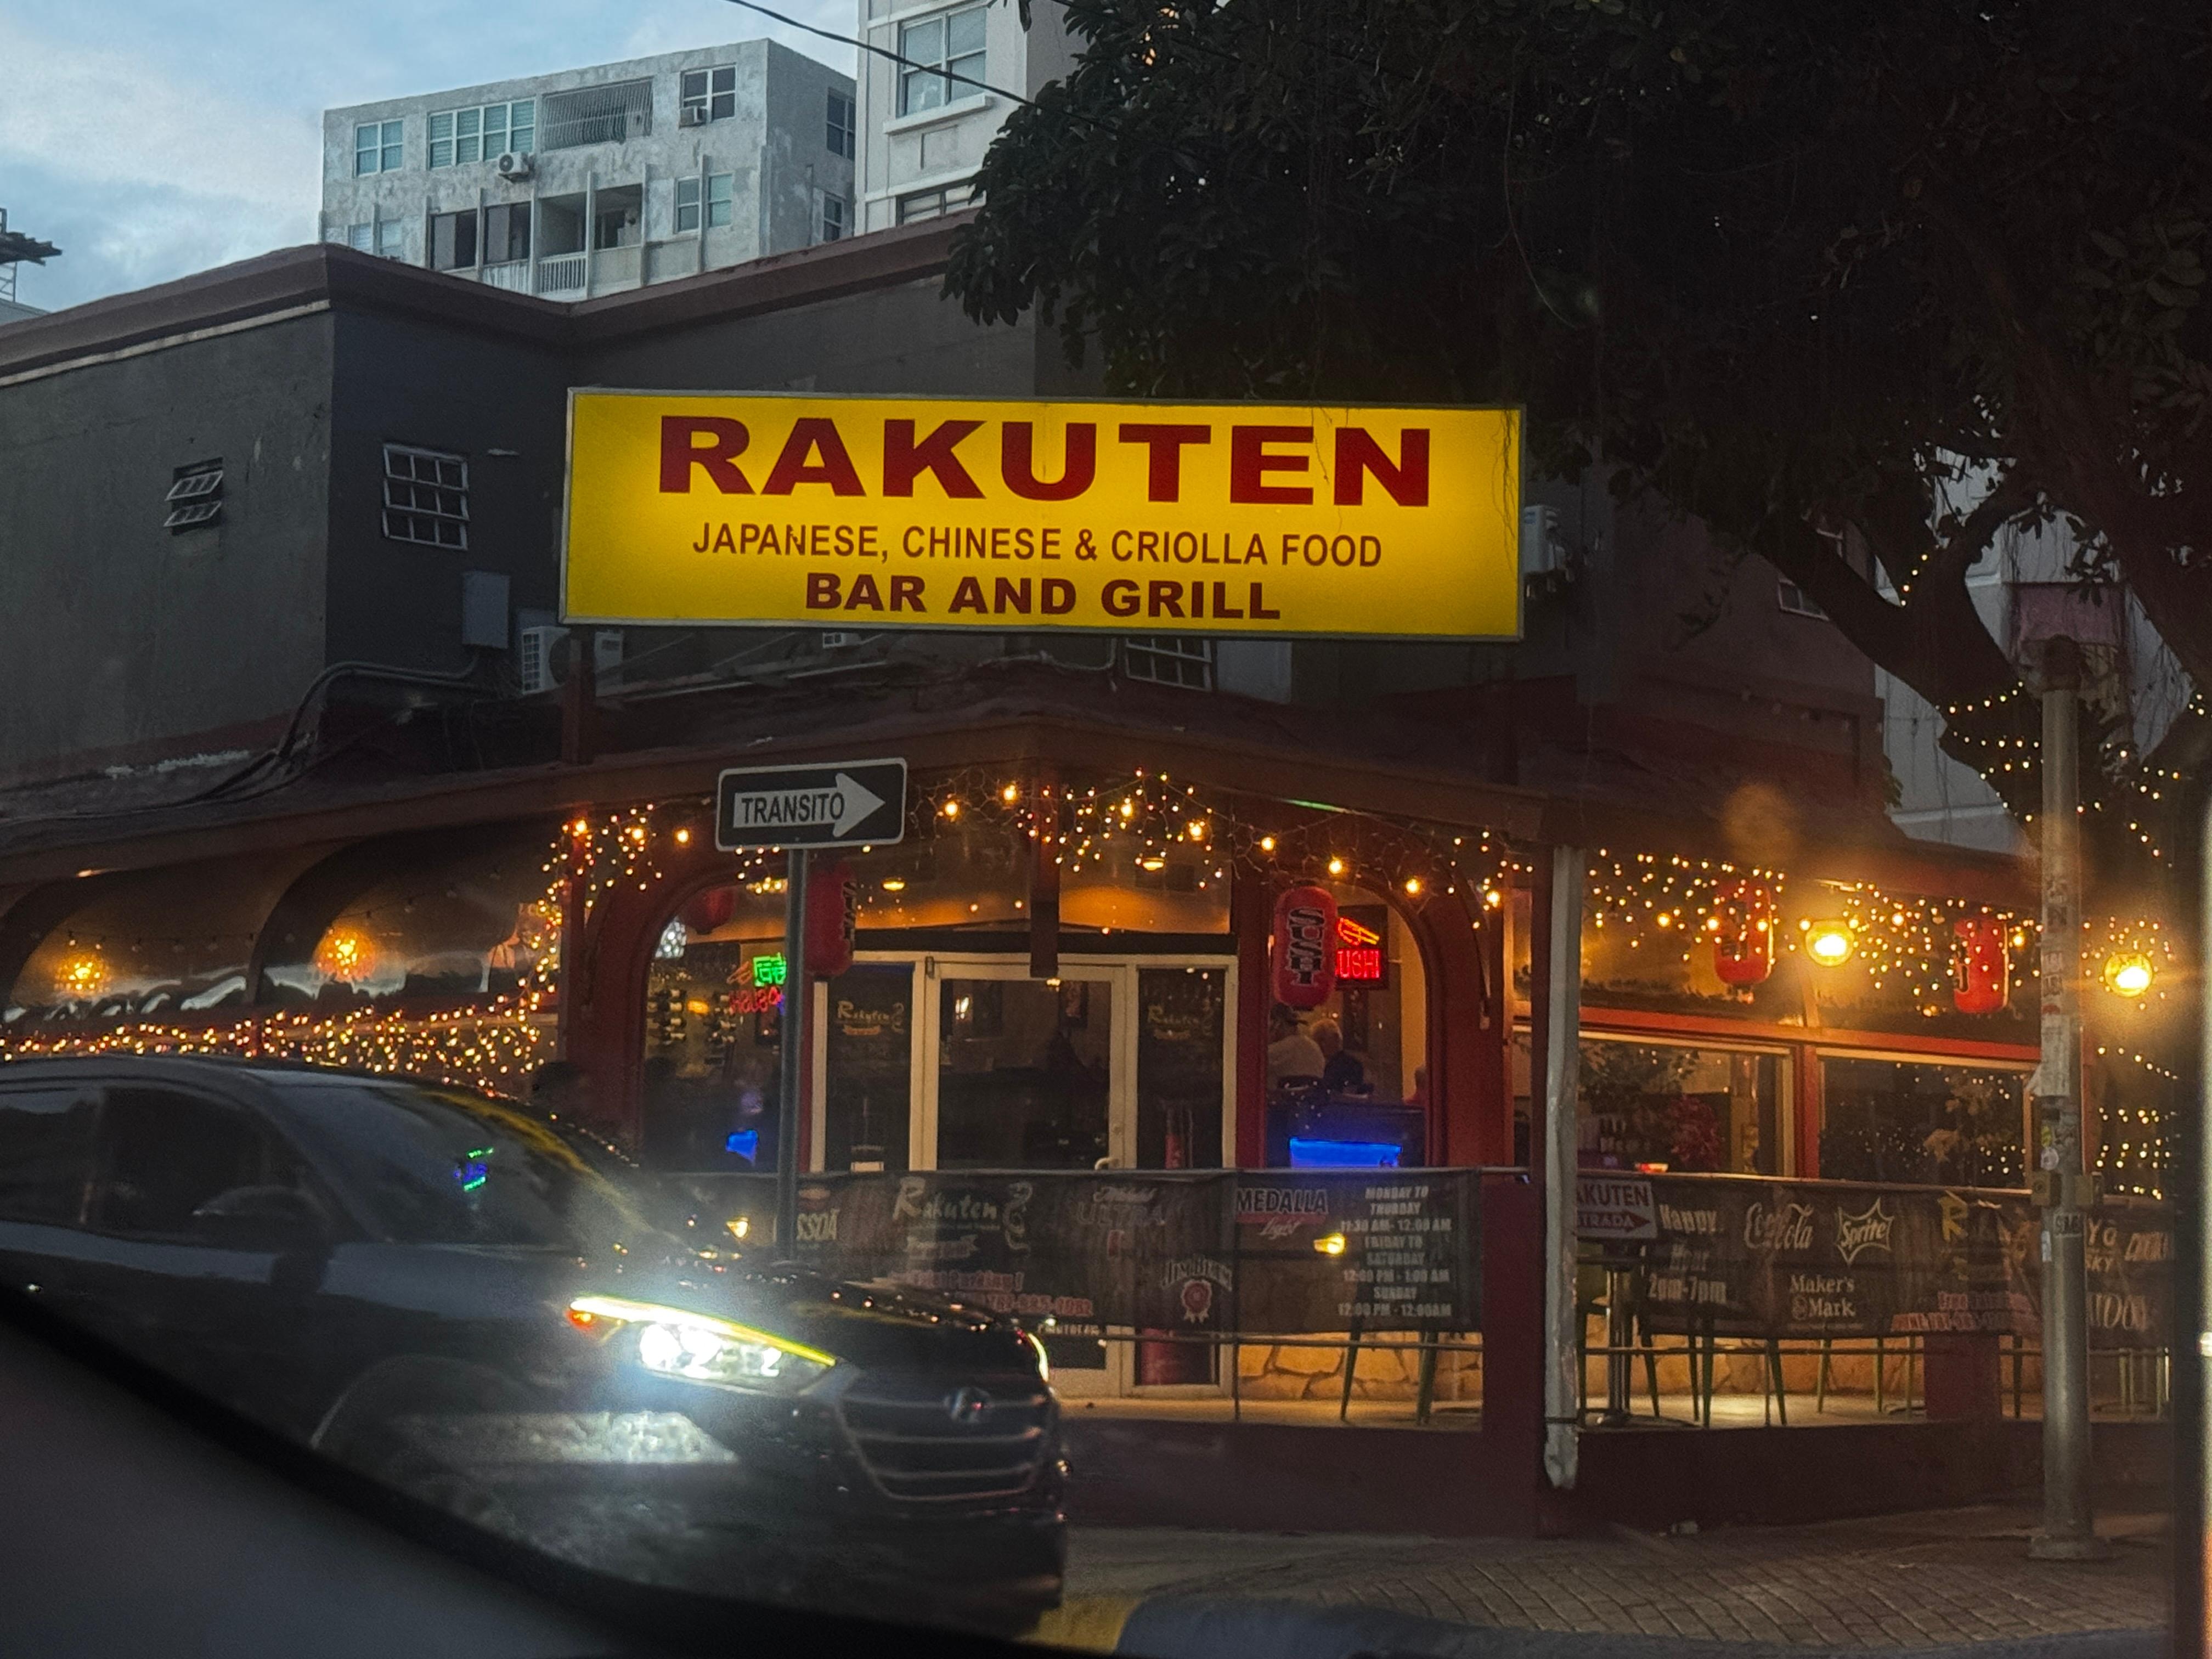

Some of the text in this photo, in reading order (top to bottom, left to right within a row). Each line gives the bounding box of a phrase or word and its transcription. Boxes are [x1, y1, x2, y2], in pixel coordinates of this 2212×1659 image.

[659, 415, 1430, 507] RAKUTEN
[693, 522, 1381, 567] JAPANESE, CHINESE & CRIOLLA FOOD
[805, 572, 1281, 620] BAR AND GRILL
[741, 792, 845, 823] TRANSITO
[1335, 949, 1380, 979] USHI
[1236, 1188, 1329, 1214] MEDALLA
[1365, 1186, 1429, 1199] MONDAY TO
[1576, 1183, 1649, 1206] AKUTEN
[1432, 1218, 1452, 1232] AM
[1577, 1214, 1634, 1229] TRADA
[1658, 1204, 1718, 1234] Happy
[1841, 1218, 1887, 1251] Sprite
[1430, 1268, 1451, 1282] AM
[1790, 1274, 1855, 1294] Maker's
[1808, 1296, 1856, 1317] Mark
